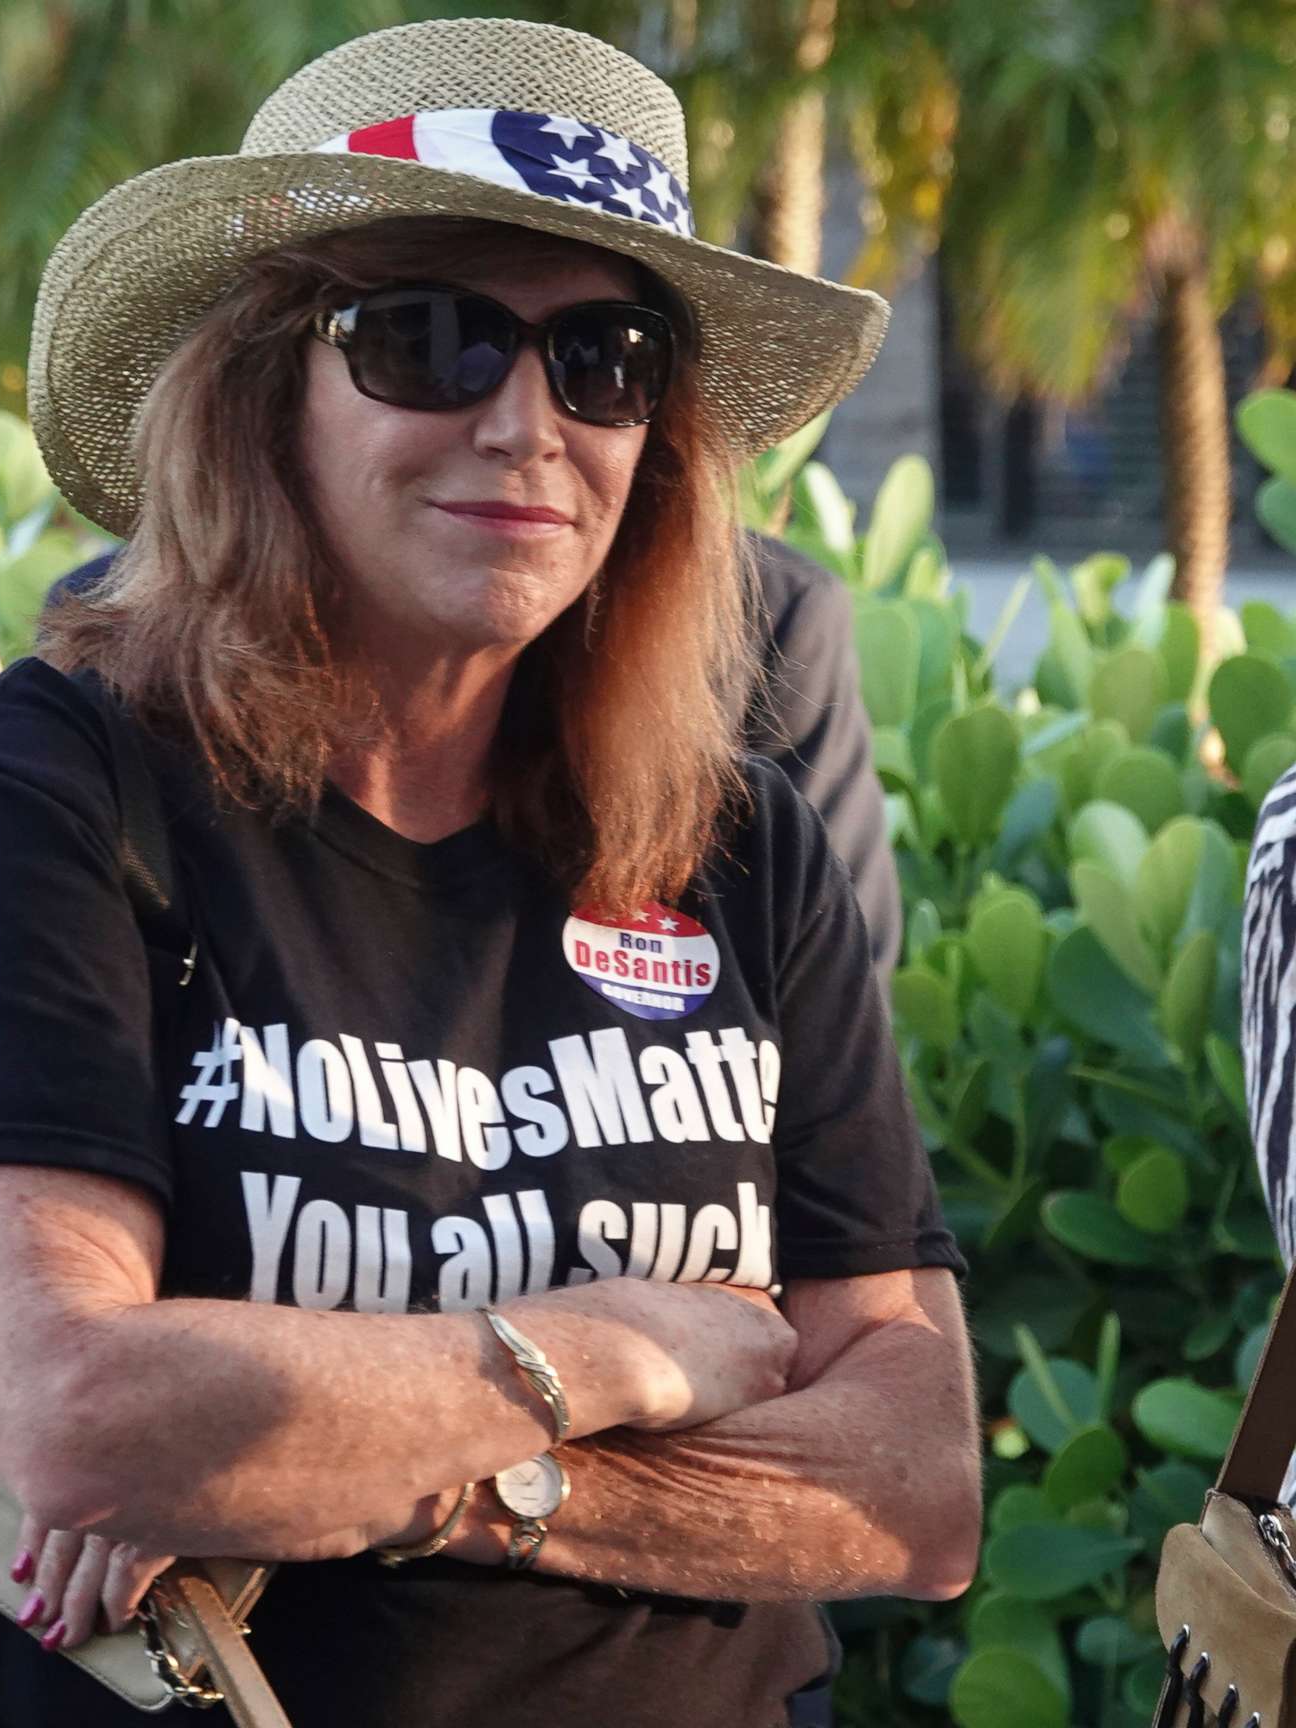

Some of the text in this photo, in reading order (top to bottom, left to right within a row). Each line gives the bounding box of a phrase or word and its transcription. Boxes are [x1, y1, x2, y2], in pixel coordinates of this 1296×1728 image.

[574, 939, 711, 987] DeSantis
[619, 932, 663, 954] Ron
[240, 1171, 412, 1313] You
[430, 1189, 556, 1313] all
